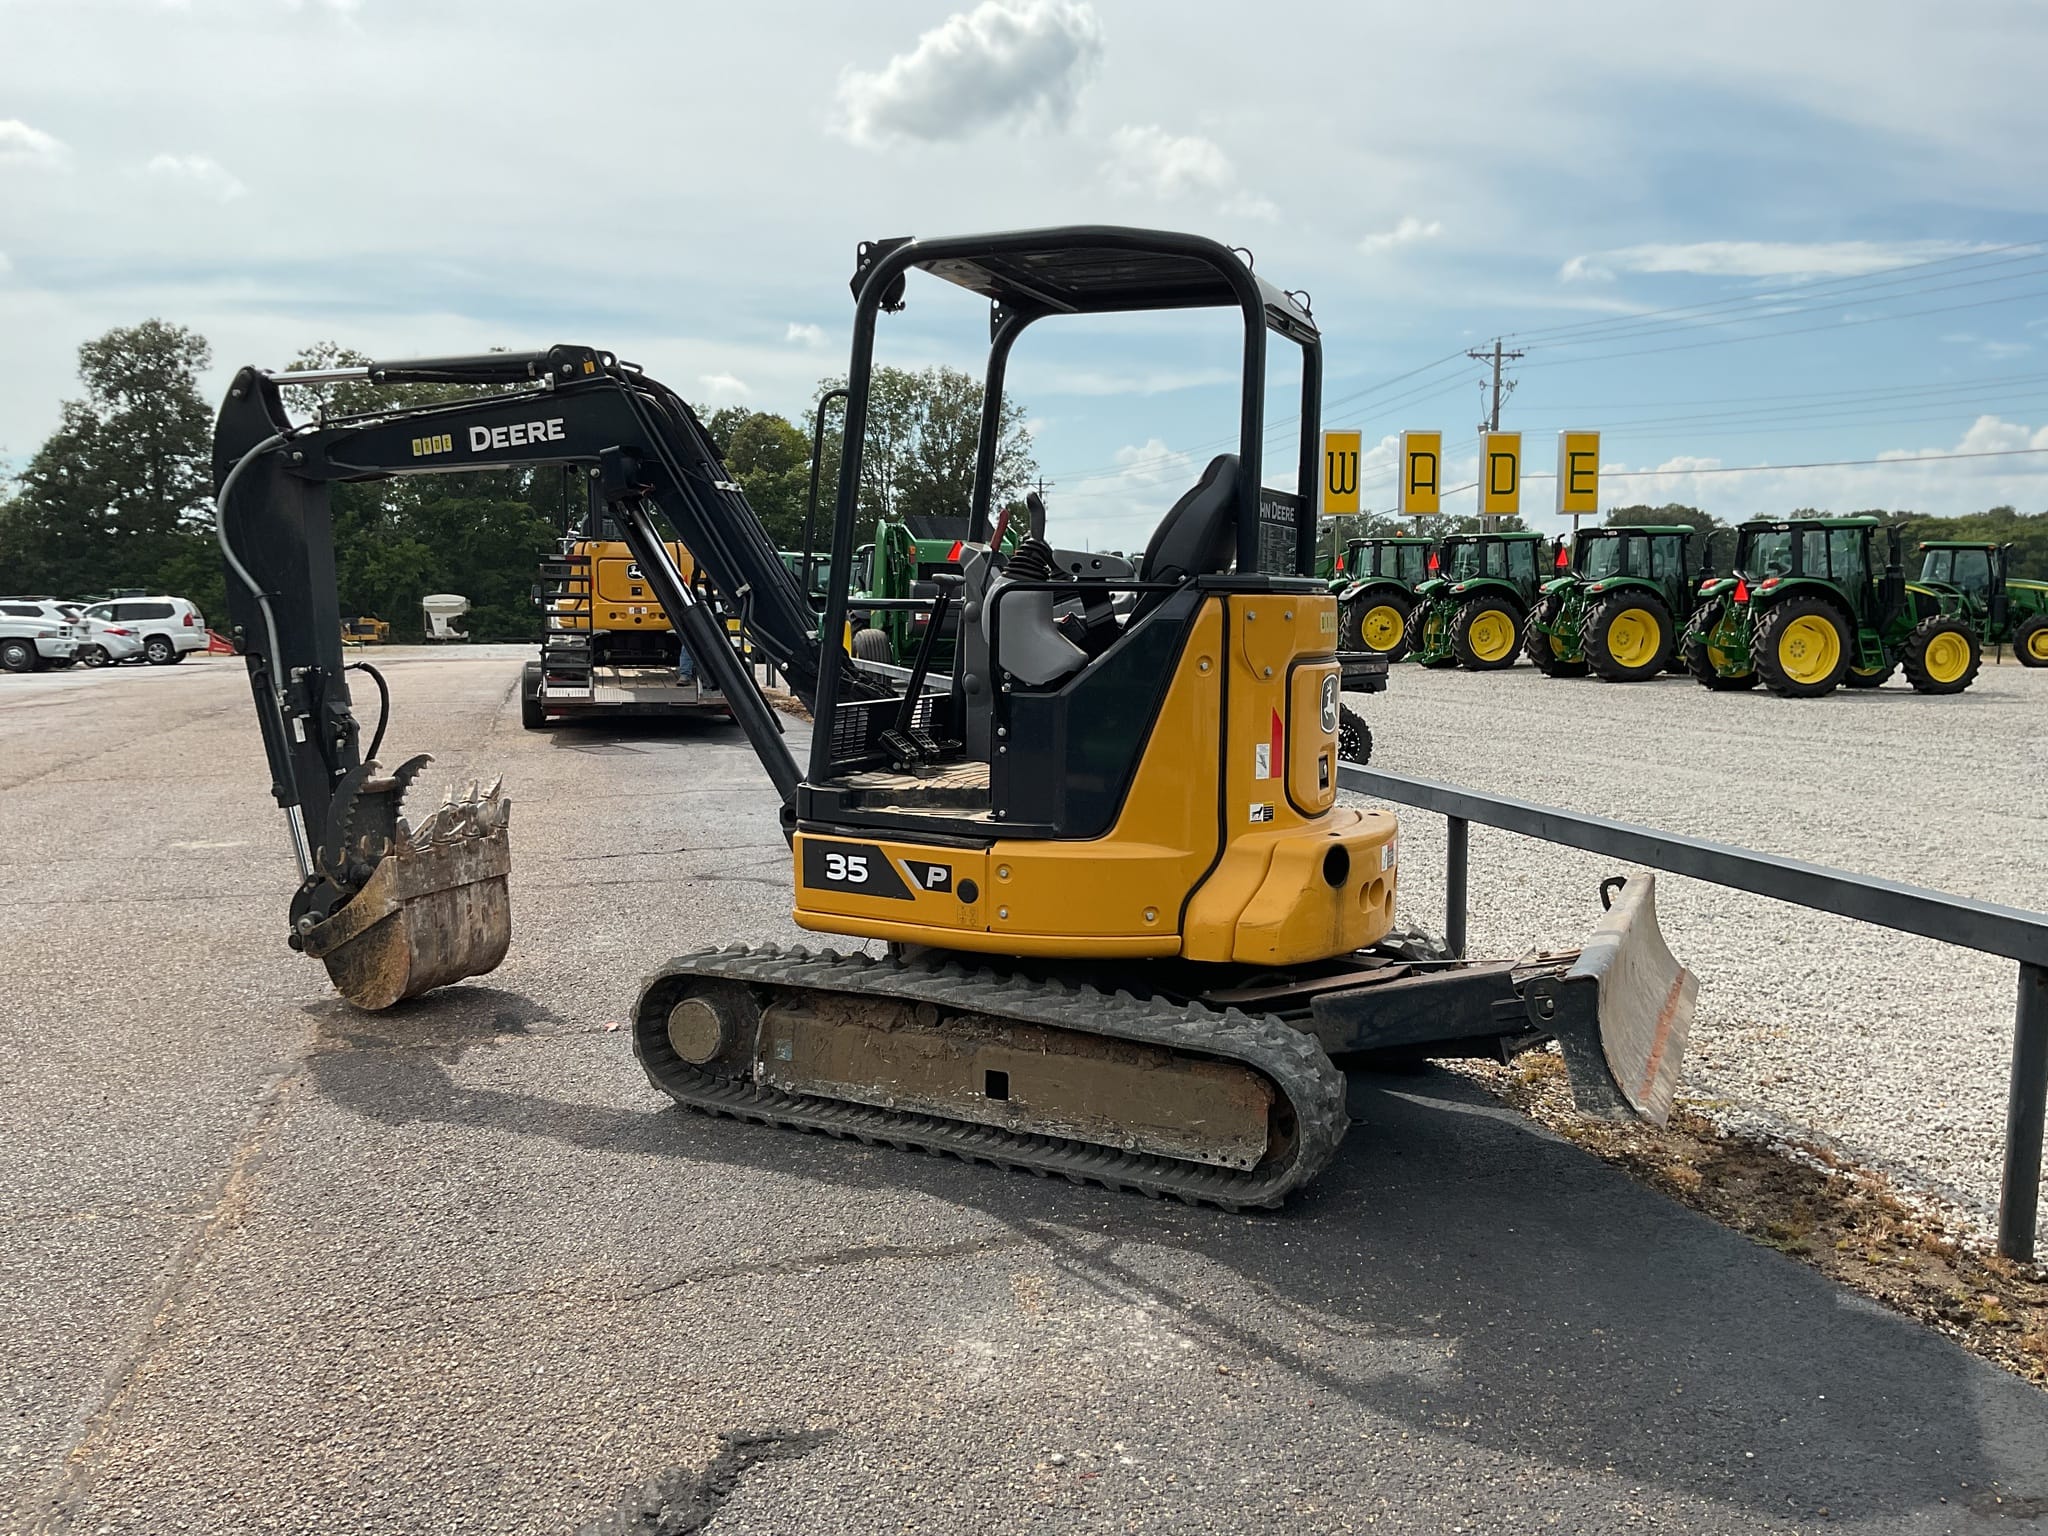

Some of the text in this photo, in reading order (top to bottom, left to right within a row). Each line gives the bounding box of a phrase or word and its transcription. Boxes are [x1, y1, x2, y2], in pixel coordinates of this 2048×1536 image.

[469, 418, 565, 452] DEERE
[1260, 501, 1295, 522] HN DEERE
[826, 853, 947, 888] 35 P
